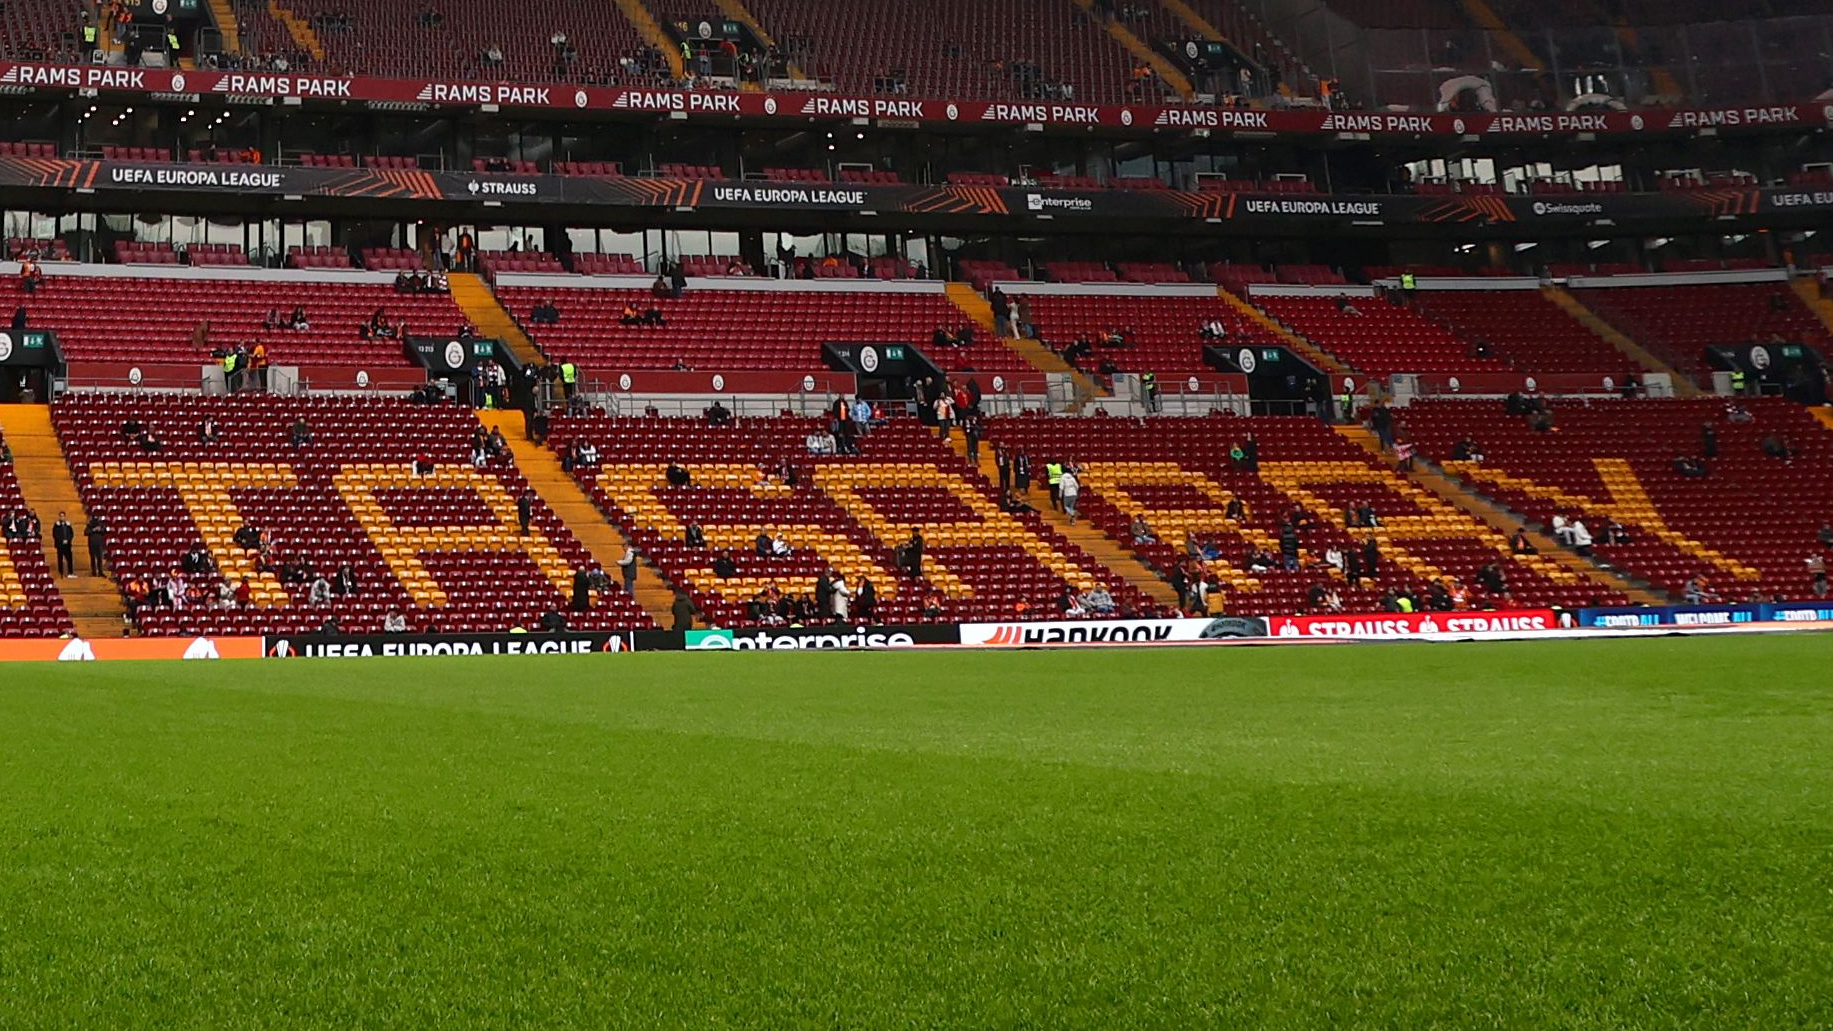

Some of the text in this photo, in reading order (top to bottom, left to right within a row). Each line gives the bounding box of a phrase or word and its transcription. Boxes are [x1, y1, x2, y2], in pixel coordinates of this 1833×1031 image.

[19, 66, 145, 88] RAMS PARK
[231, 75, 352, 97] RAMS PARK
[434, 84, 550, 105] RAMS PARK
[629, 91, 741, 112] RAMS PARK
[816, 98, 924, 118] RAMS PARK
[996, 105, 1100, 124] RAMS PARK
[1683, 106, 1799, 127] RAMS PARK
[1169, 109, 1268, 128] RAMS PARK
[1333, 115, 1433, 132] RAMS PARK
[1501, 115, 1608, 132] RAMS PARK
[112, 168, 280, 187] UEFA EUROPA LEAGUE
[481, 182, 537, 195] STRAUSS
[714, 186, 864, 204] UEFA EUROPA LEAGUE
[1032, 197, 1092, 209] enterprise
[1247, 200, 1380, 215] UEFA EUROPA LEAGUE
[1546, 201, 1602, 215] Swissquote
[1771, 193, 1812, 207] UEFA
[1308, 620, 1411, 636] STRAUSS
[1447, 617, 1545, 631] STRAUSS
